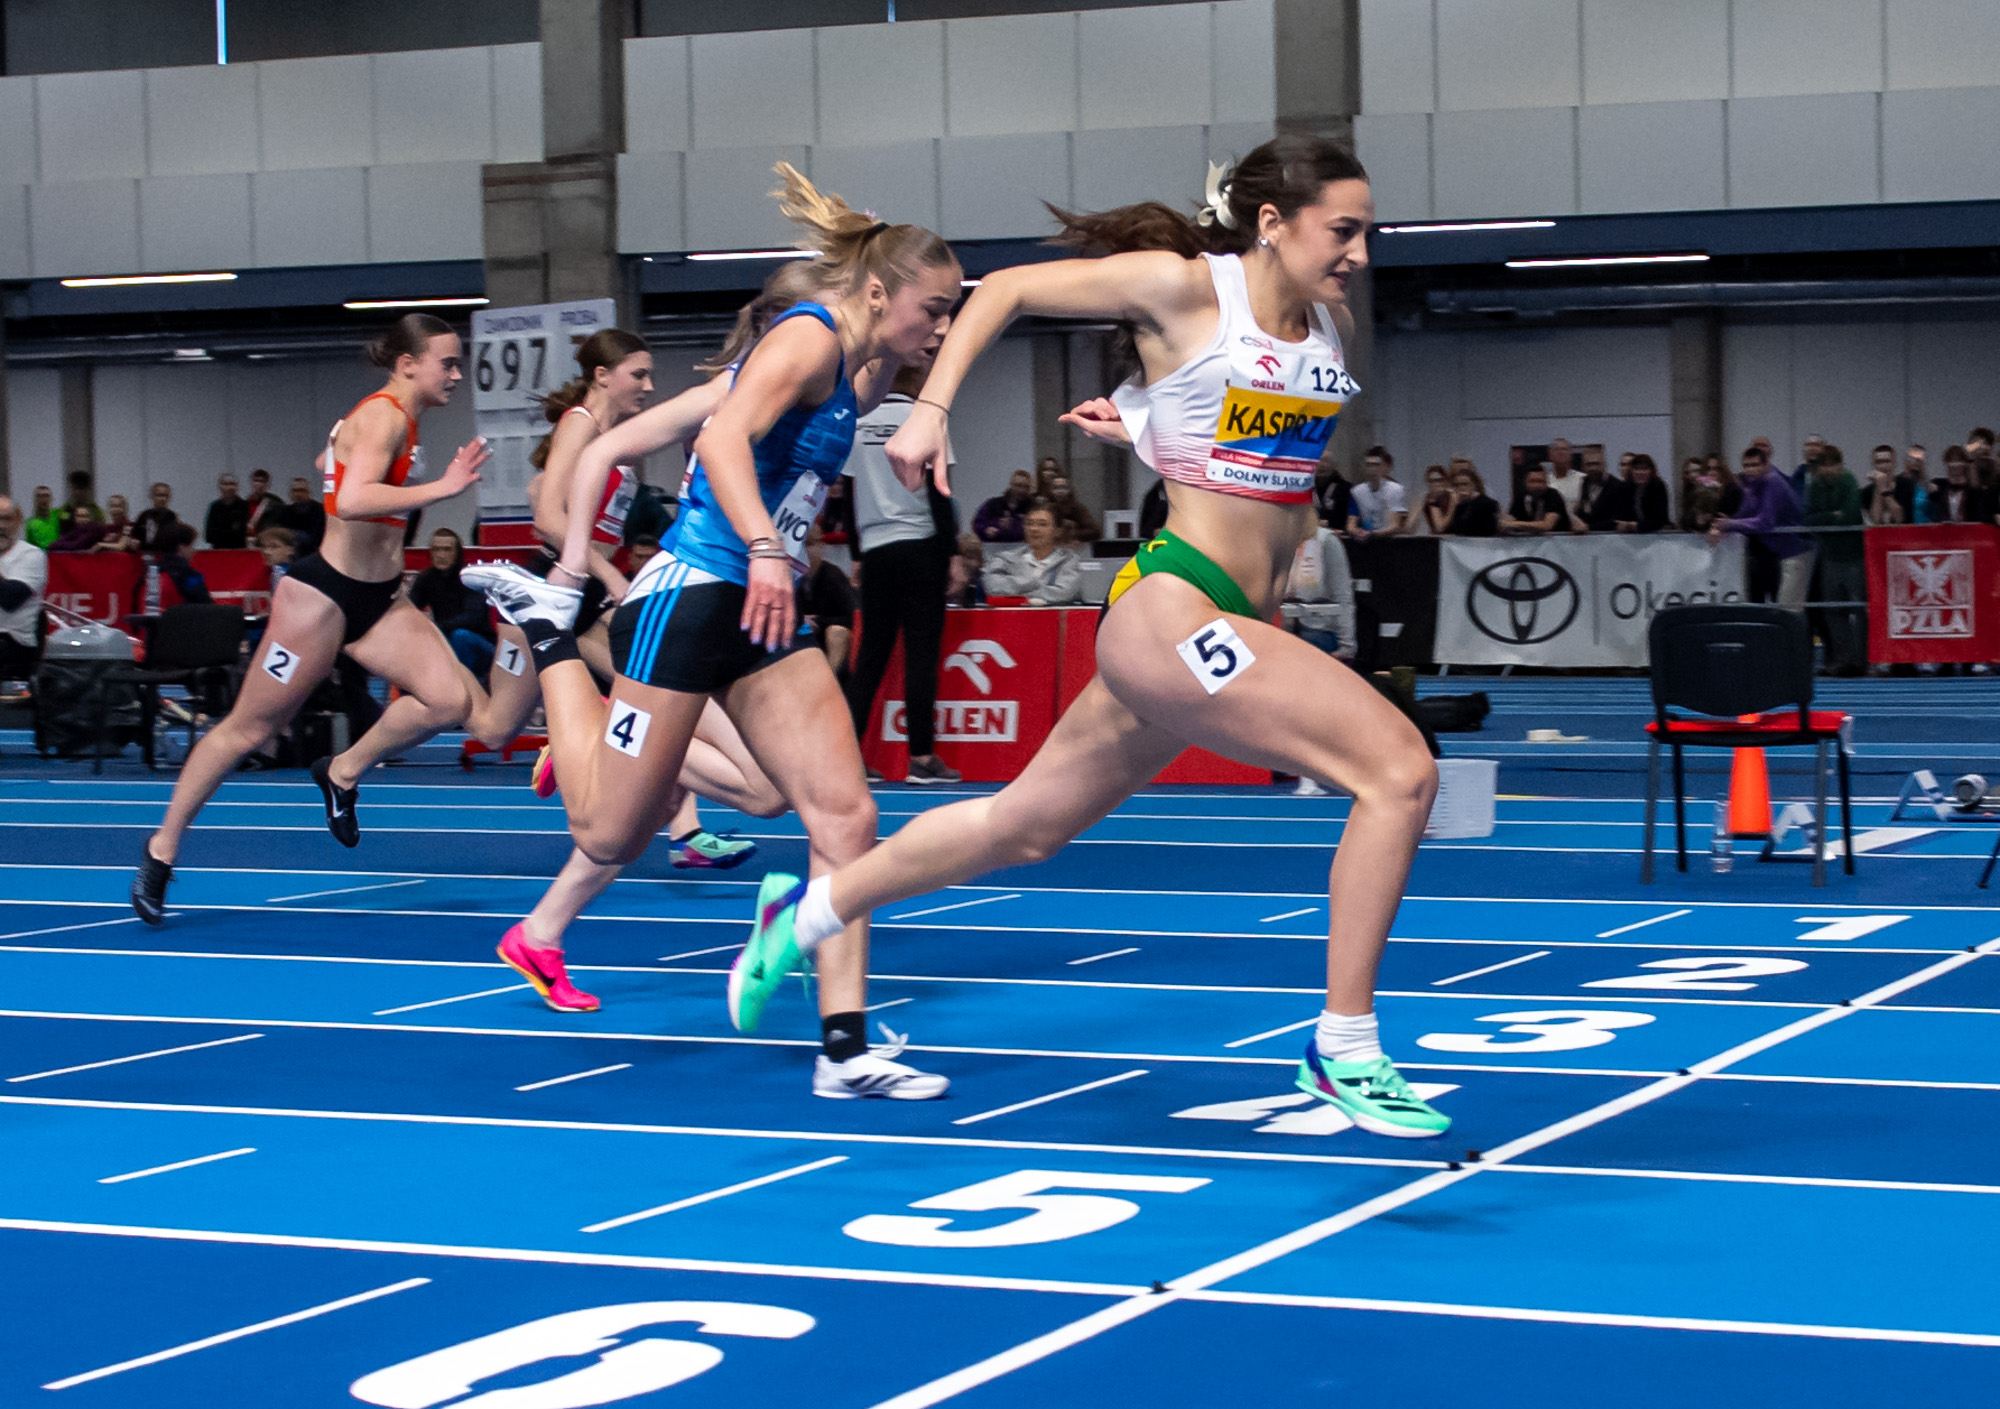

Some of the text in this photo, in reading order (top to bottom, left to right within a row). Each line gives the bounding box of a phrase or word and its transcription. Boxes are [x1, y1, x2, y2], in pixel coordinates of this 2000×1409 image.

[476, 338, 547, 392] 697
[1251, 378, 1285, 392] ORLEN
[1223, 467, 1269, 485] DOLNY
[1891, 608, 1972, 634] PZLA
[268, 650, 291, 678] 2
[506, 648, 520, 671] 1
[1193, 628, 1237, 678] 5
[612, 711, 638, 749] 4
[892, 706, 1007, 735] OLEN
[1794, 915, 1913, 941] 1
[1579, 956, 1811, 991] 2
[1416, 1009, 1657, 1053] 3
[843, 1169, 1215, 1248] 5
[349, 1300, 818, 1409] 6
